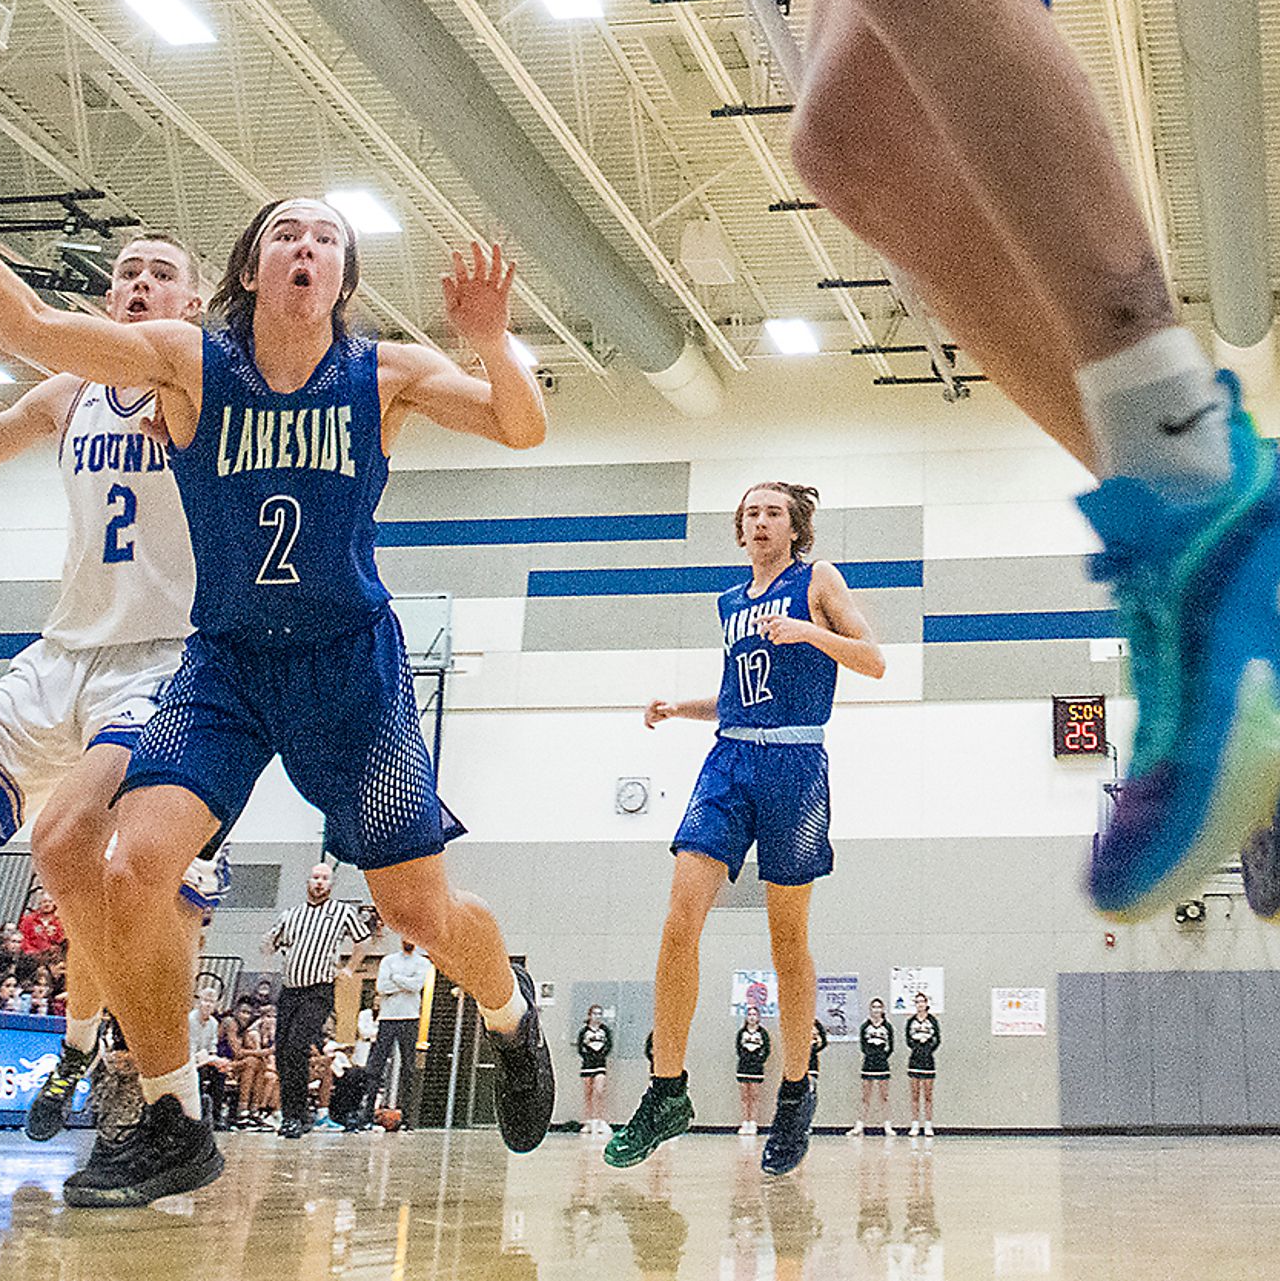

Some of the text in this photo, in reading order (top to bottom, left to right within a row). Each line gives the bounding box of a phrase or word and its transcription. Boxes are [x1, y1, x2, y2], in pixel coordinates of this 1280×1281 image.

[73, 433, 173, 475] HOUND
[218, 404, 356, 477] LAKESIDE
[103, 483, 138, 564] 2
[255, 494, 302, 585] 2
[736, 649, 773, 707] 12
[1064, 721, 1099, 750] 25
[1068, 704, 1104, 721] 5:04
